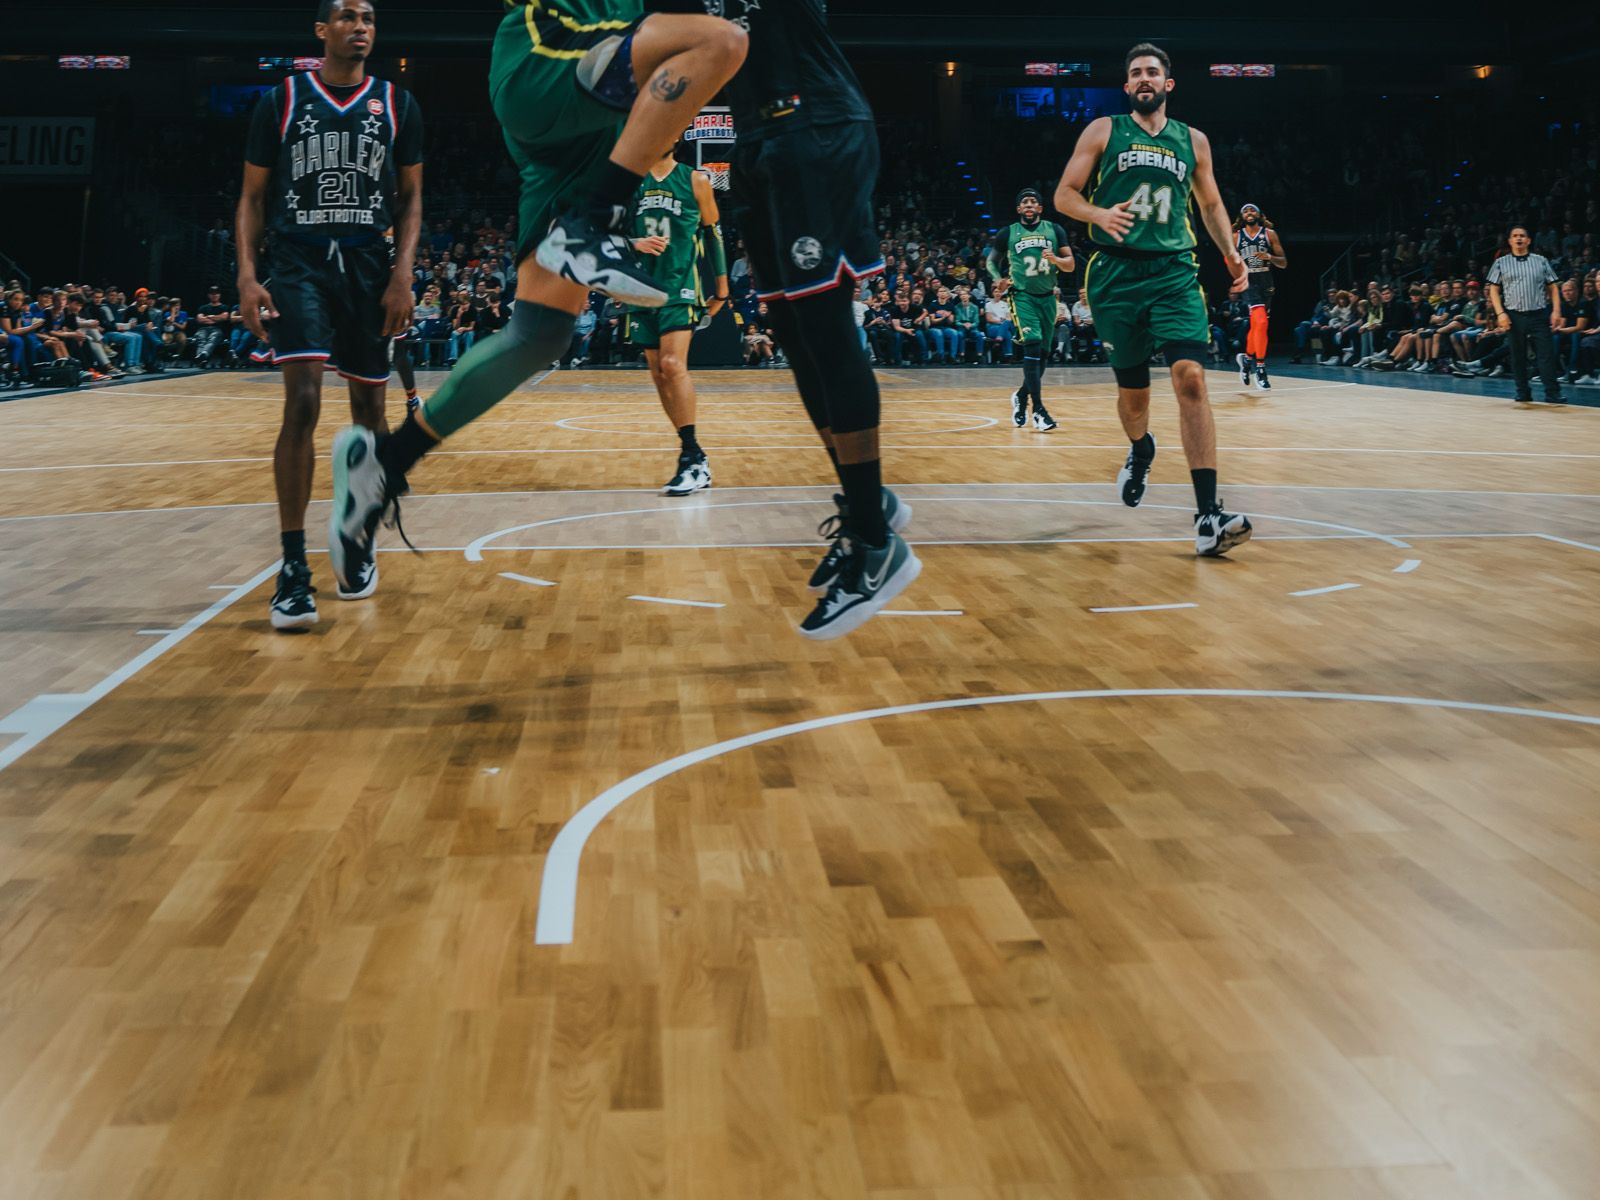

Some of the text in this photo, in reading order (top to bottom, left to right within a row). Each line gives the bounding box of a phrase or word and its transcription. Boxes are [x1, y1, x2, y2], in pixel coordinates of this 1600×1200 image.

[693, 115, 733, 128] HARLE
[291, 131, 386, 181] HARLEM
[1118, 150, 1187, 182] GENERALS
[317, 171, 360, 206] 21
[1127, 183, 1172, 224] 41
[1023, 256, 1051, 277] 24
